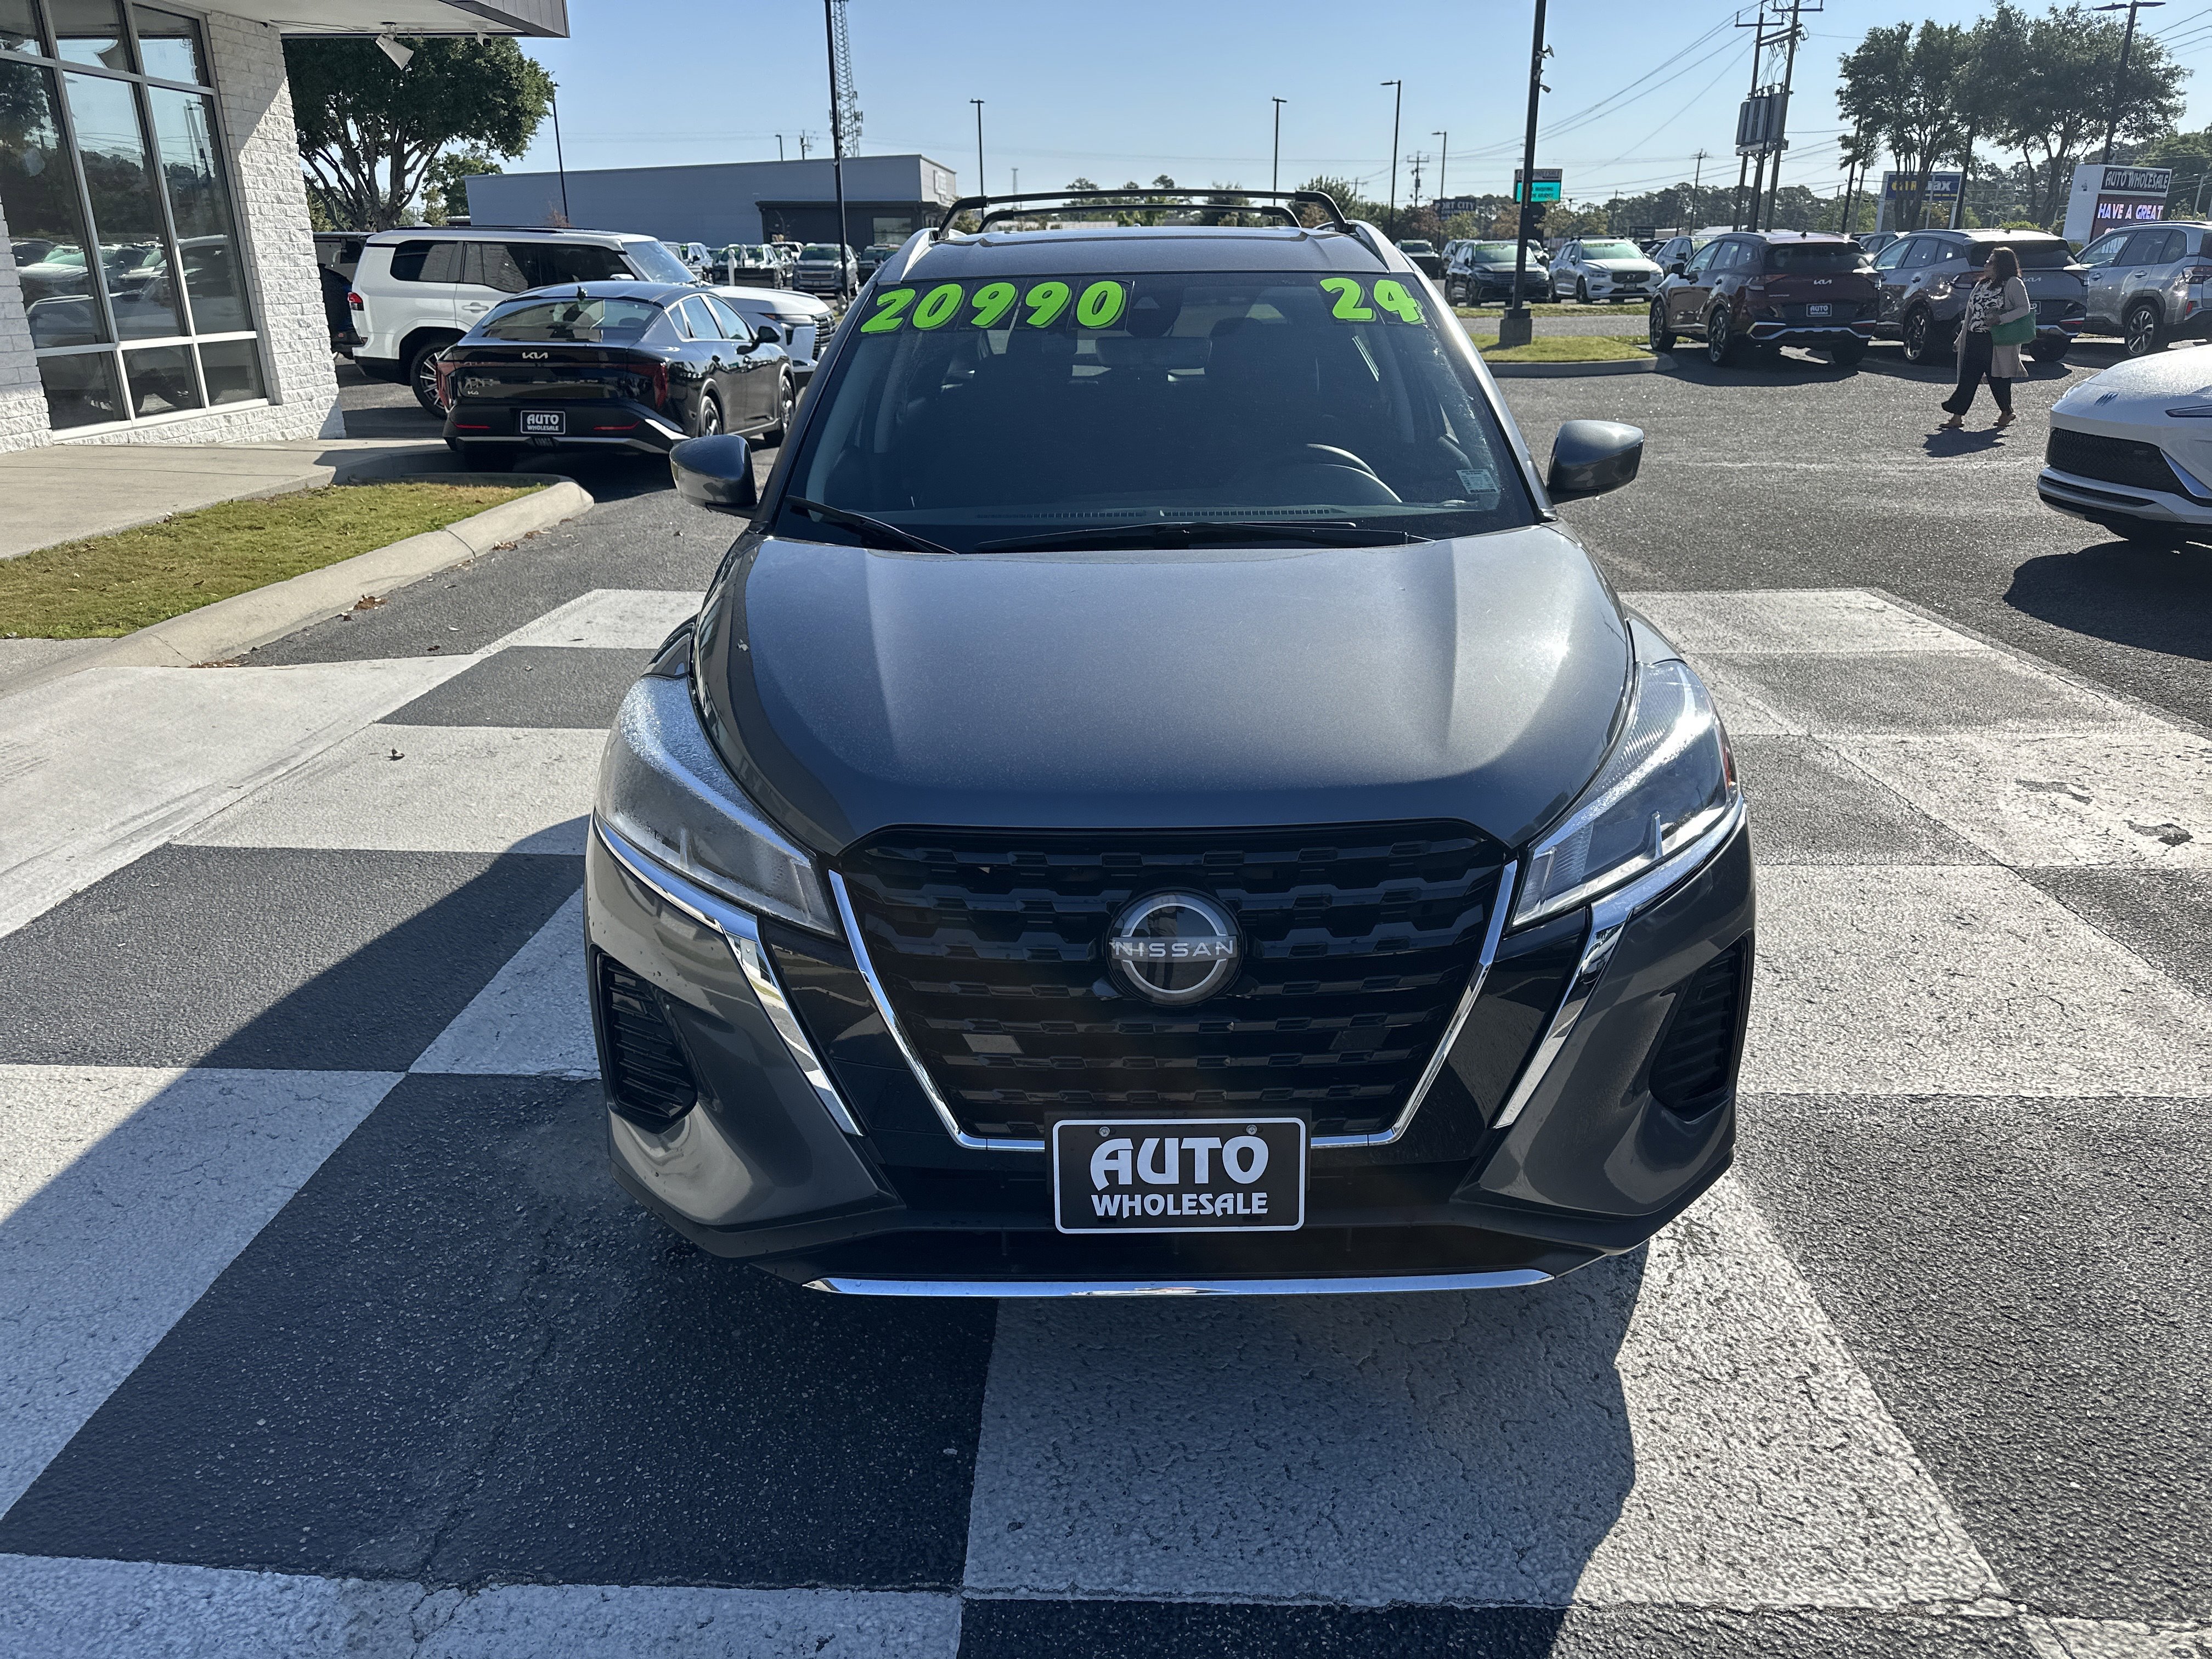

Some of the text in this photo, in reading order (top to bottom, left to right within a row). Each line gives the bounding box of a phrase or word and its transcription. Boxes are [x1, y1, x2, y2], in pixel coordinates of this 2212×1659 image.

[2105, 171, 2169, 190] AUTO WHOLESALE
[2097, 203, 2164, 220] HAVE A GREAT
[861, 280, 1126, 332] 20990
[1319, 278, 1424, 325] 24
[527, 414, 559, 425] AUTO
[1115, 940, 1233, 957] NISSAN
[1090, 1136, 1269, 1191] AUTO
[1091, 1192, 1268, 1219] WHOLESALE
